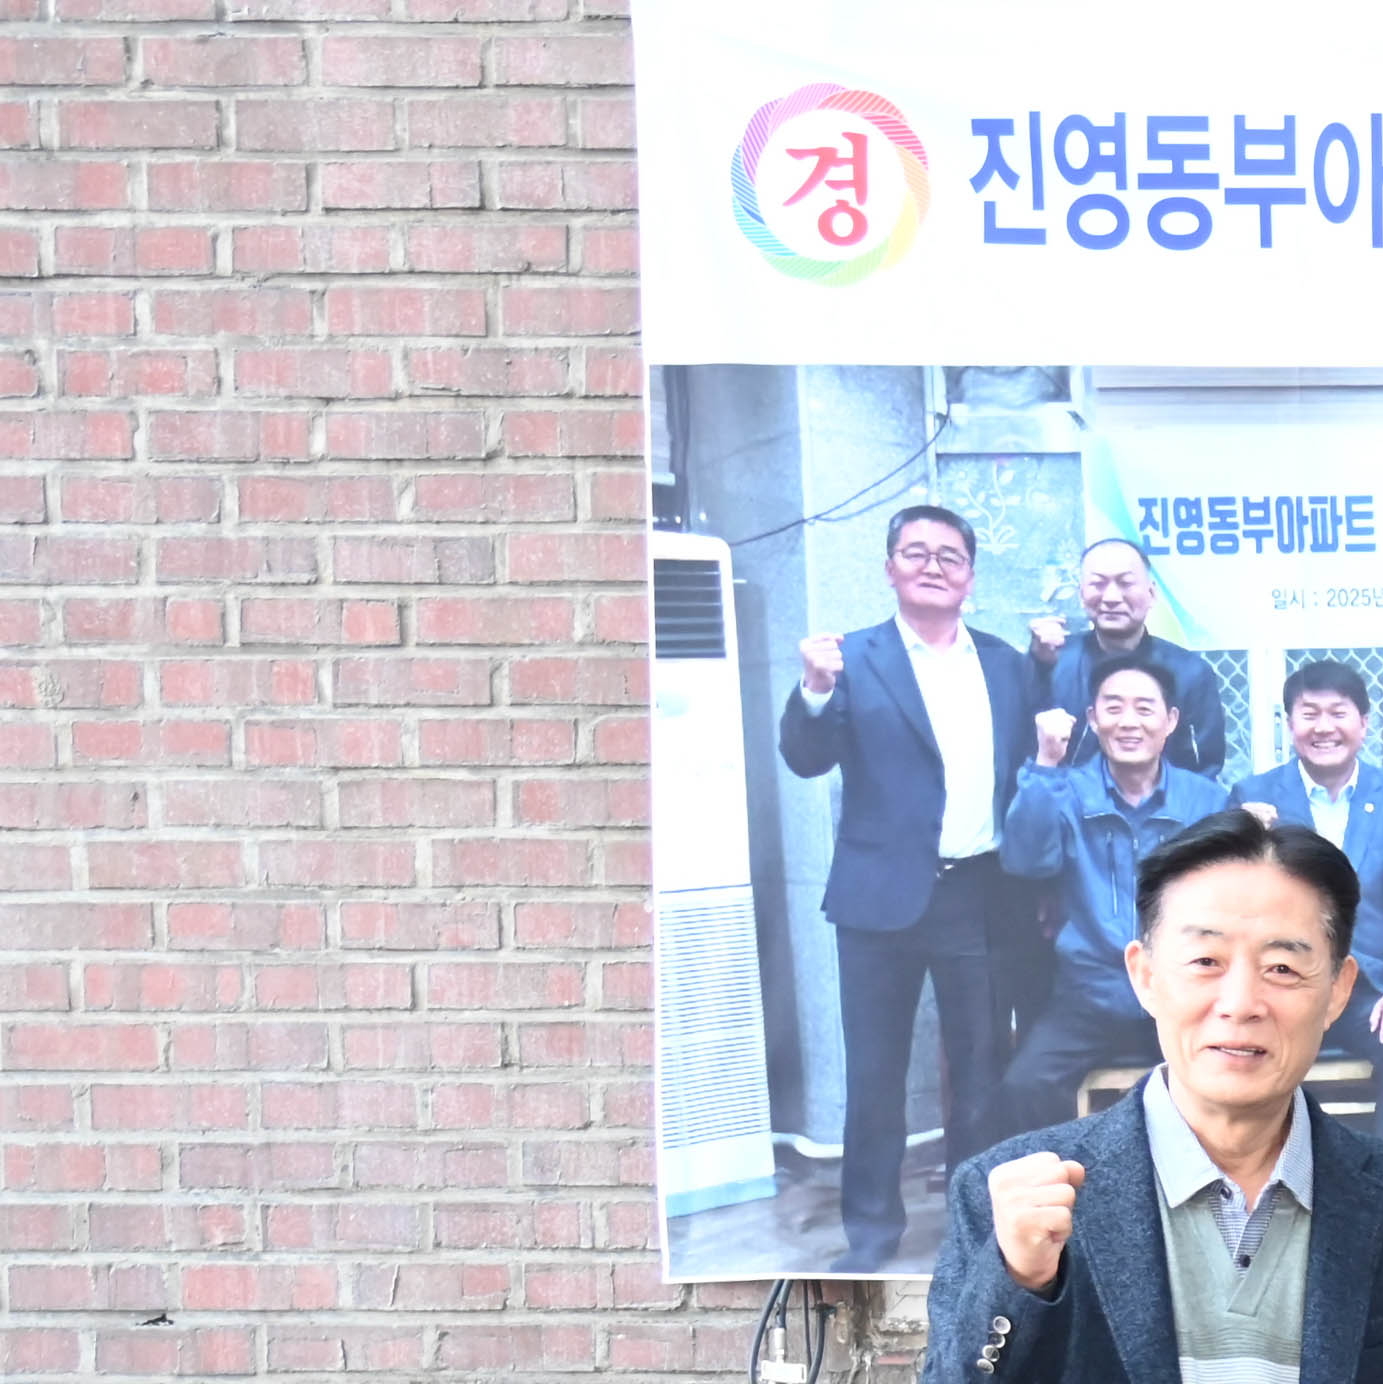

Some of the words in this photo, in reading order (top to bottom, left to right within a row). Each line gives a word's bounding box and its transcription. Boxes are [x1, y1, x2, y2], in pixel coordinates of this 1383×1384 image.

[783, 131, 872, 248] 경
[1137, 495, 1377, 556] 진영동부아파트
[1271, 588, 1306, 610] 일시
